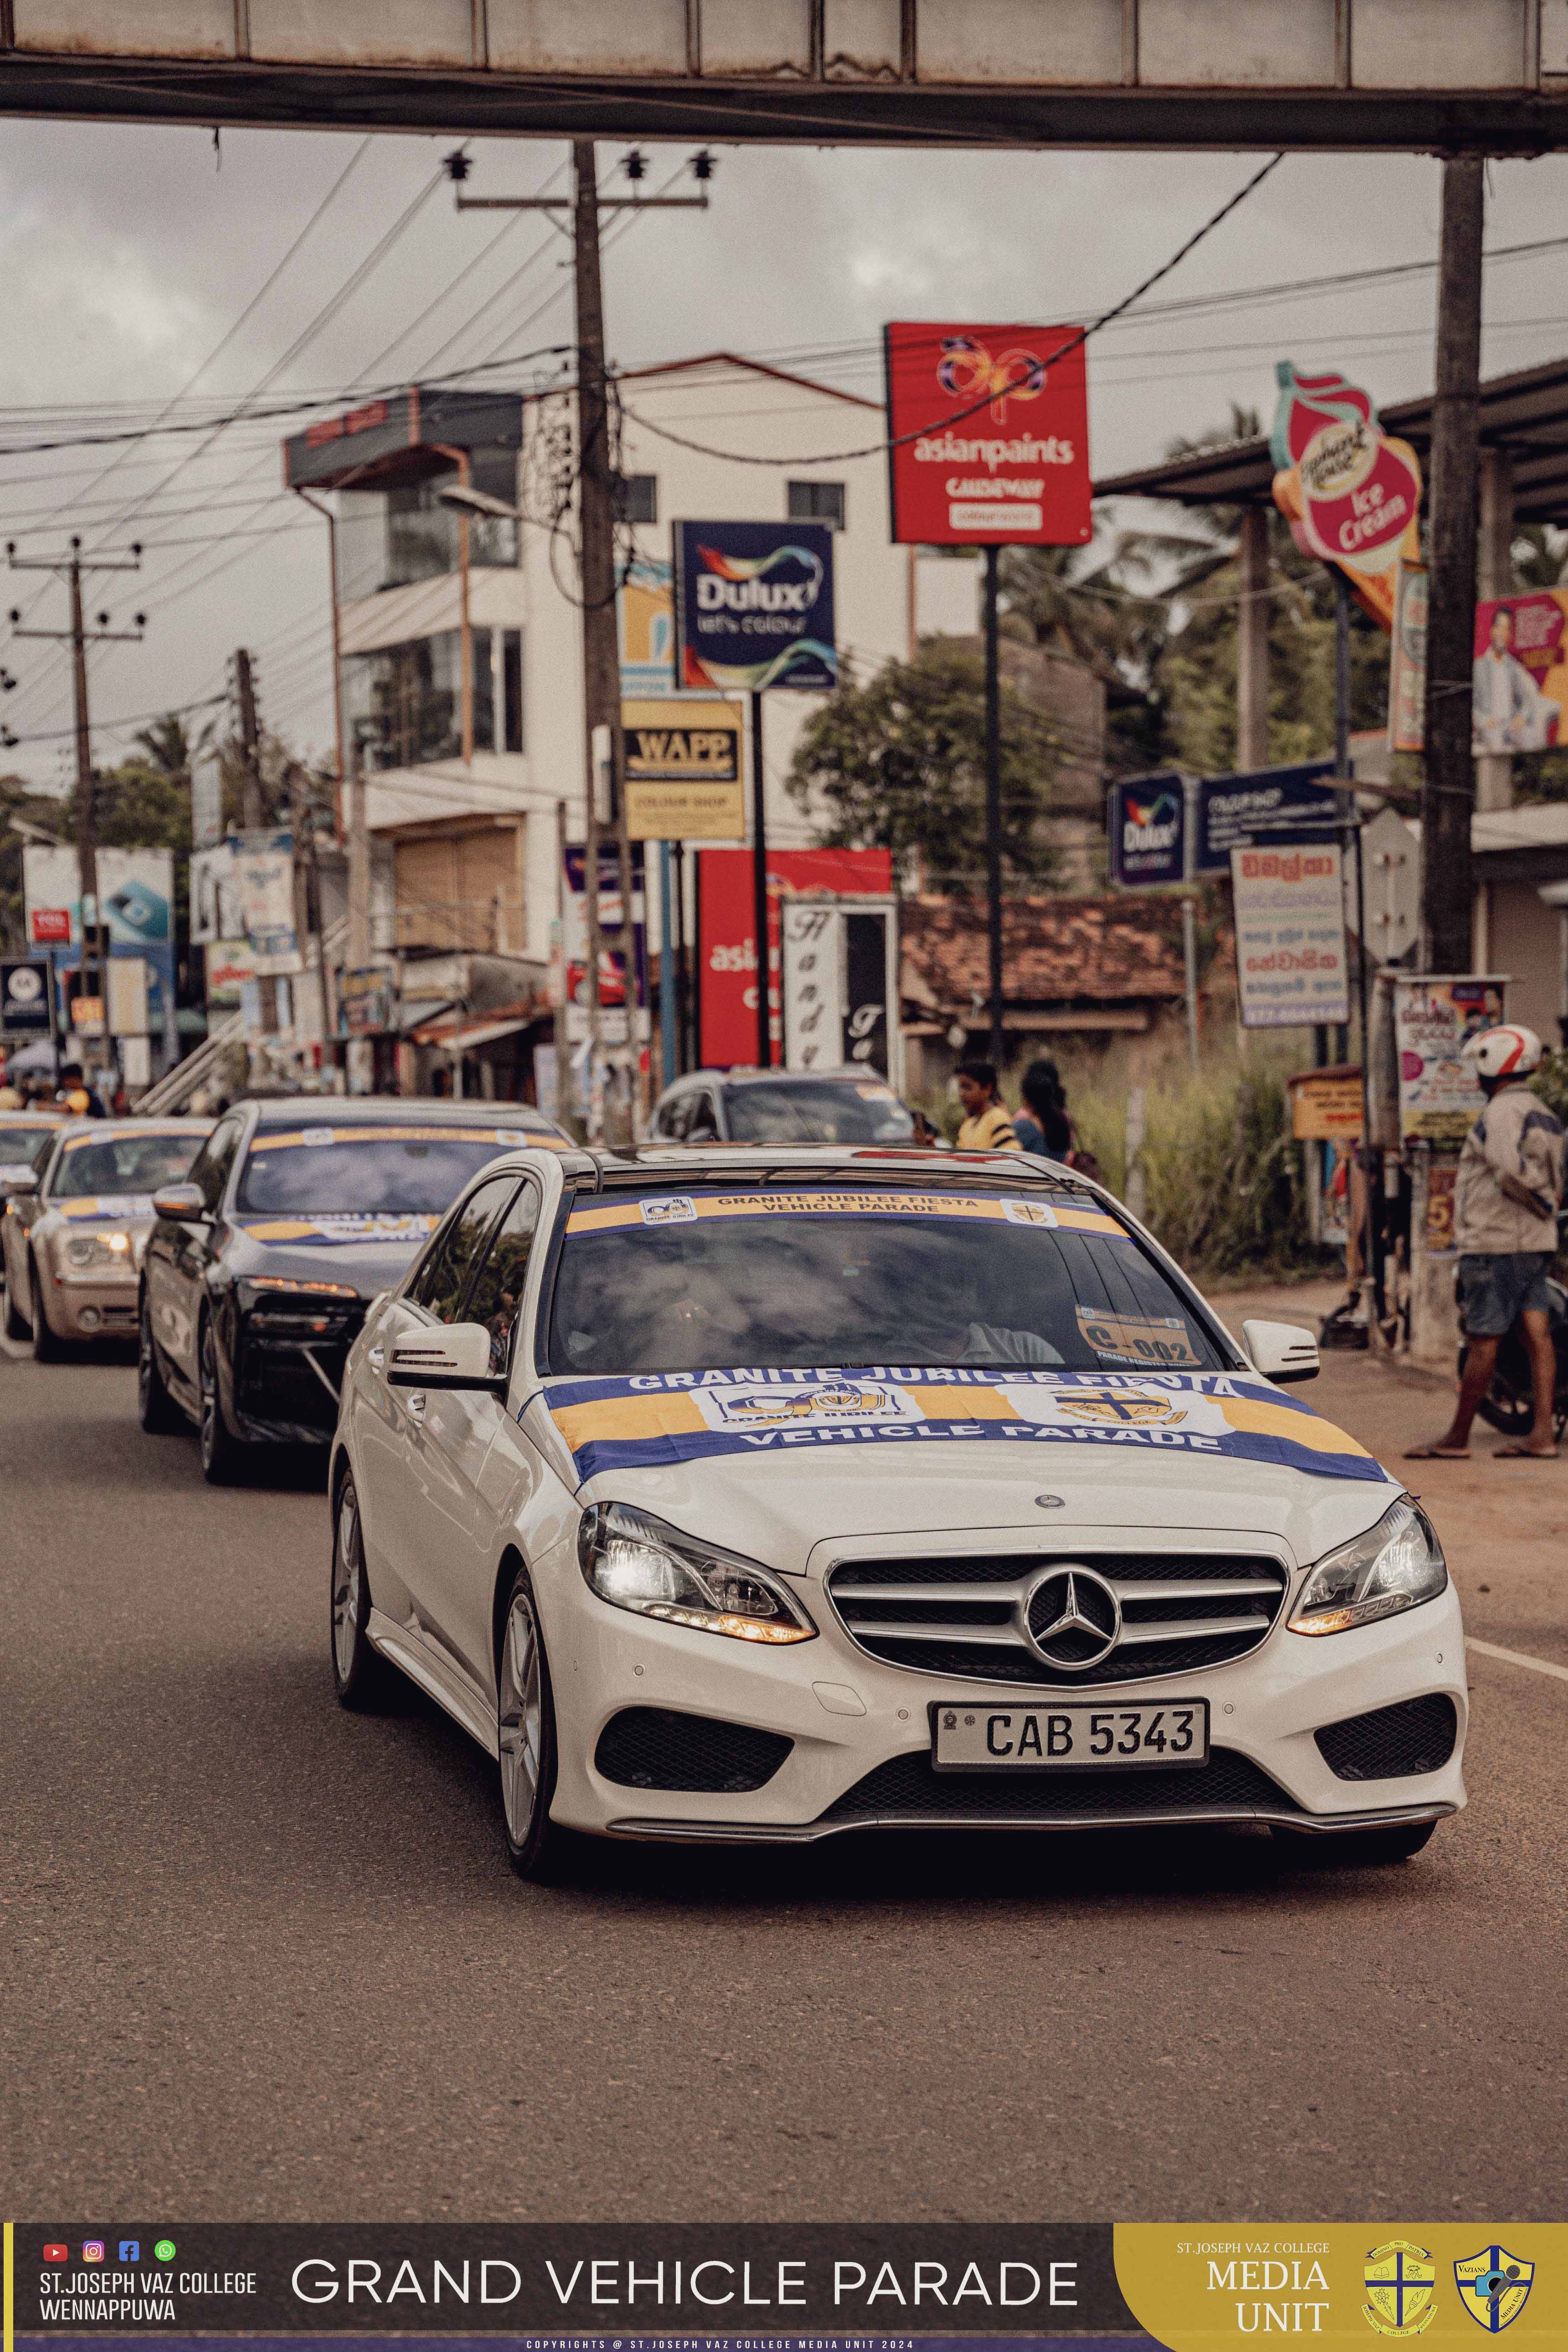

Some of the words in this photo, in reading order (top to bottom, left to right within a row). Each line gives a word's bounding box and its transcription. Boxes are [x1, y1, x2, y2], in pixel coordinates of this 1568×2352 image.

[913, 431, 1075, 474] asianpaints
[1351, 483, 1384, 518] Ice
[1339, 494, 1407, 550] Cream
[696, 573, 810, 612] Dulux
[636, 731, 731, 759] WAPP
[718, 1196, 808, 1205] GRANITE
[909, 1197, 978, 1207] FIESTA
[763, 1203, 852, 1211] VEHICLE
[860, 1203, 940, 1213] PARADE
[1097, 1351, 1129, 1363] PARADE
[629, 1367, 842, 1390] GRANITE
[860, 1367, 1064, 1385] JUBILEE
[739, 1424, 985, 1445] VEHICLE
[1001, 1425, 1223, 1451] PARADE
[986, 1714, 1074, 1756] CAB
[1090, 1710, 1194, 1755] 5343
